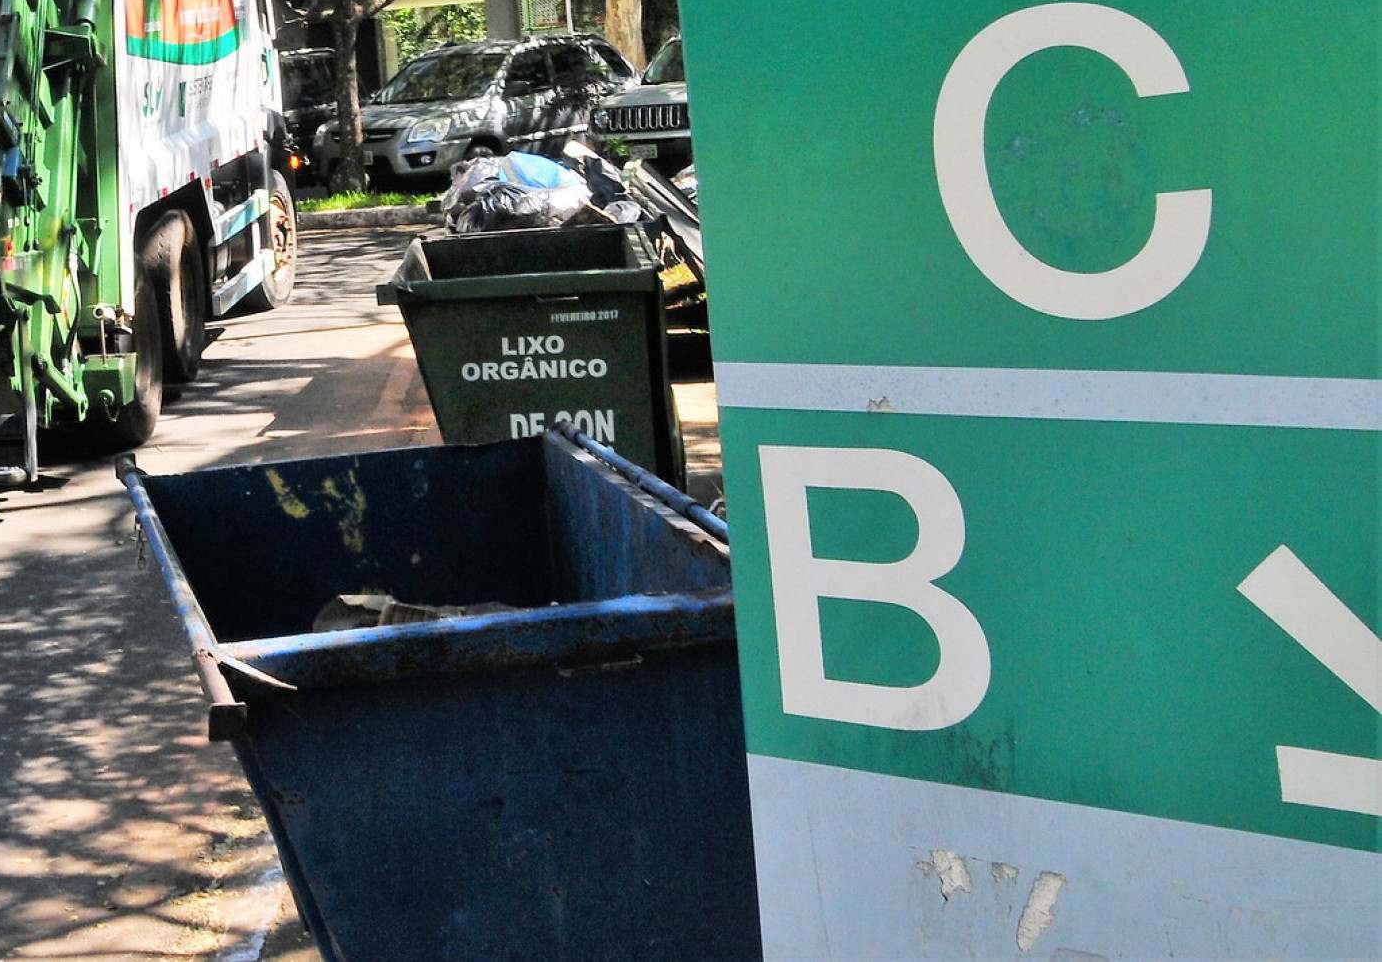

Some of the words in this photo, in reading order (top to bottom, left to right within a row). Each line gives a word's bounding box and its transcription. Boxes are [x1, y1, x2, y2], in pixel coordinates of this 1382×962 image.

[933, 2, 1213, 320] C
[501, 335, 565, 356] LIXO
[461, 357, 608, 382] ORGÂNICO
[509, 412, 545, 440] DE
[758, 444, 991, 731] B
